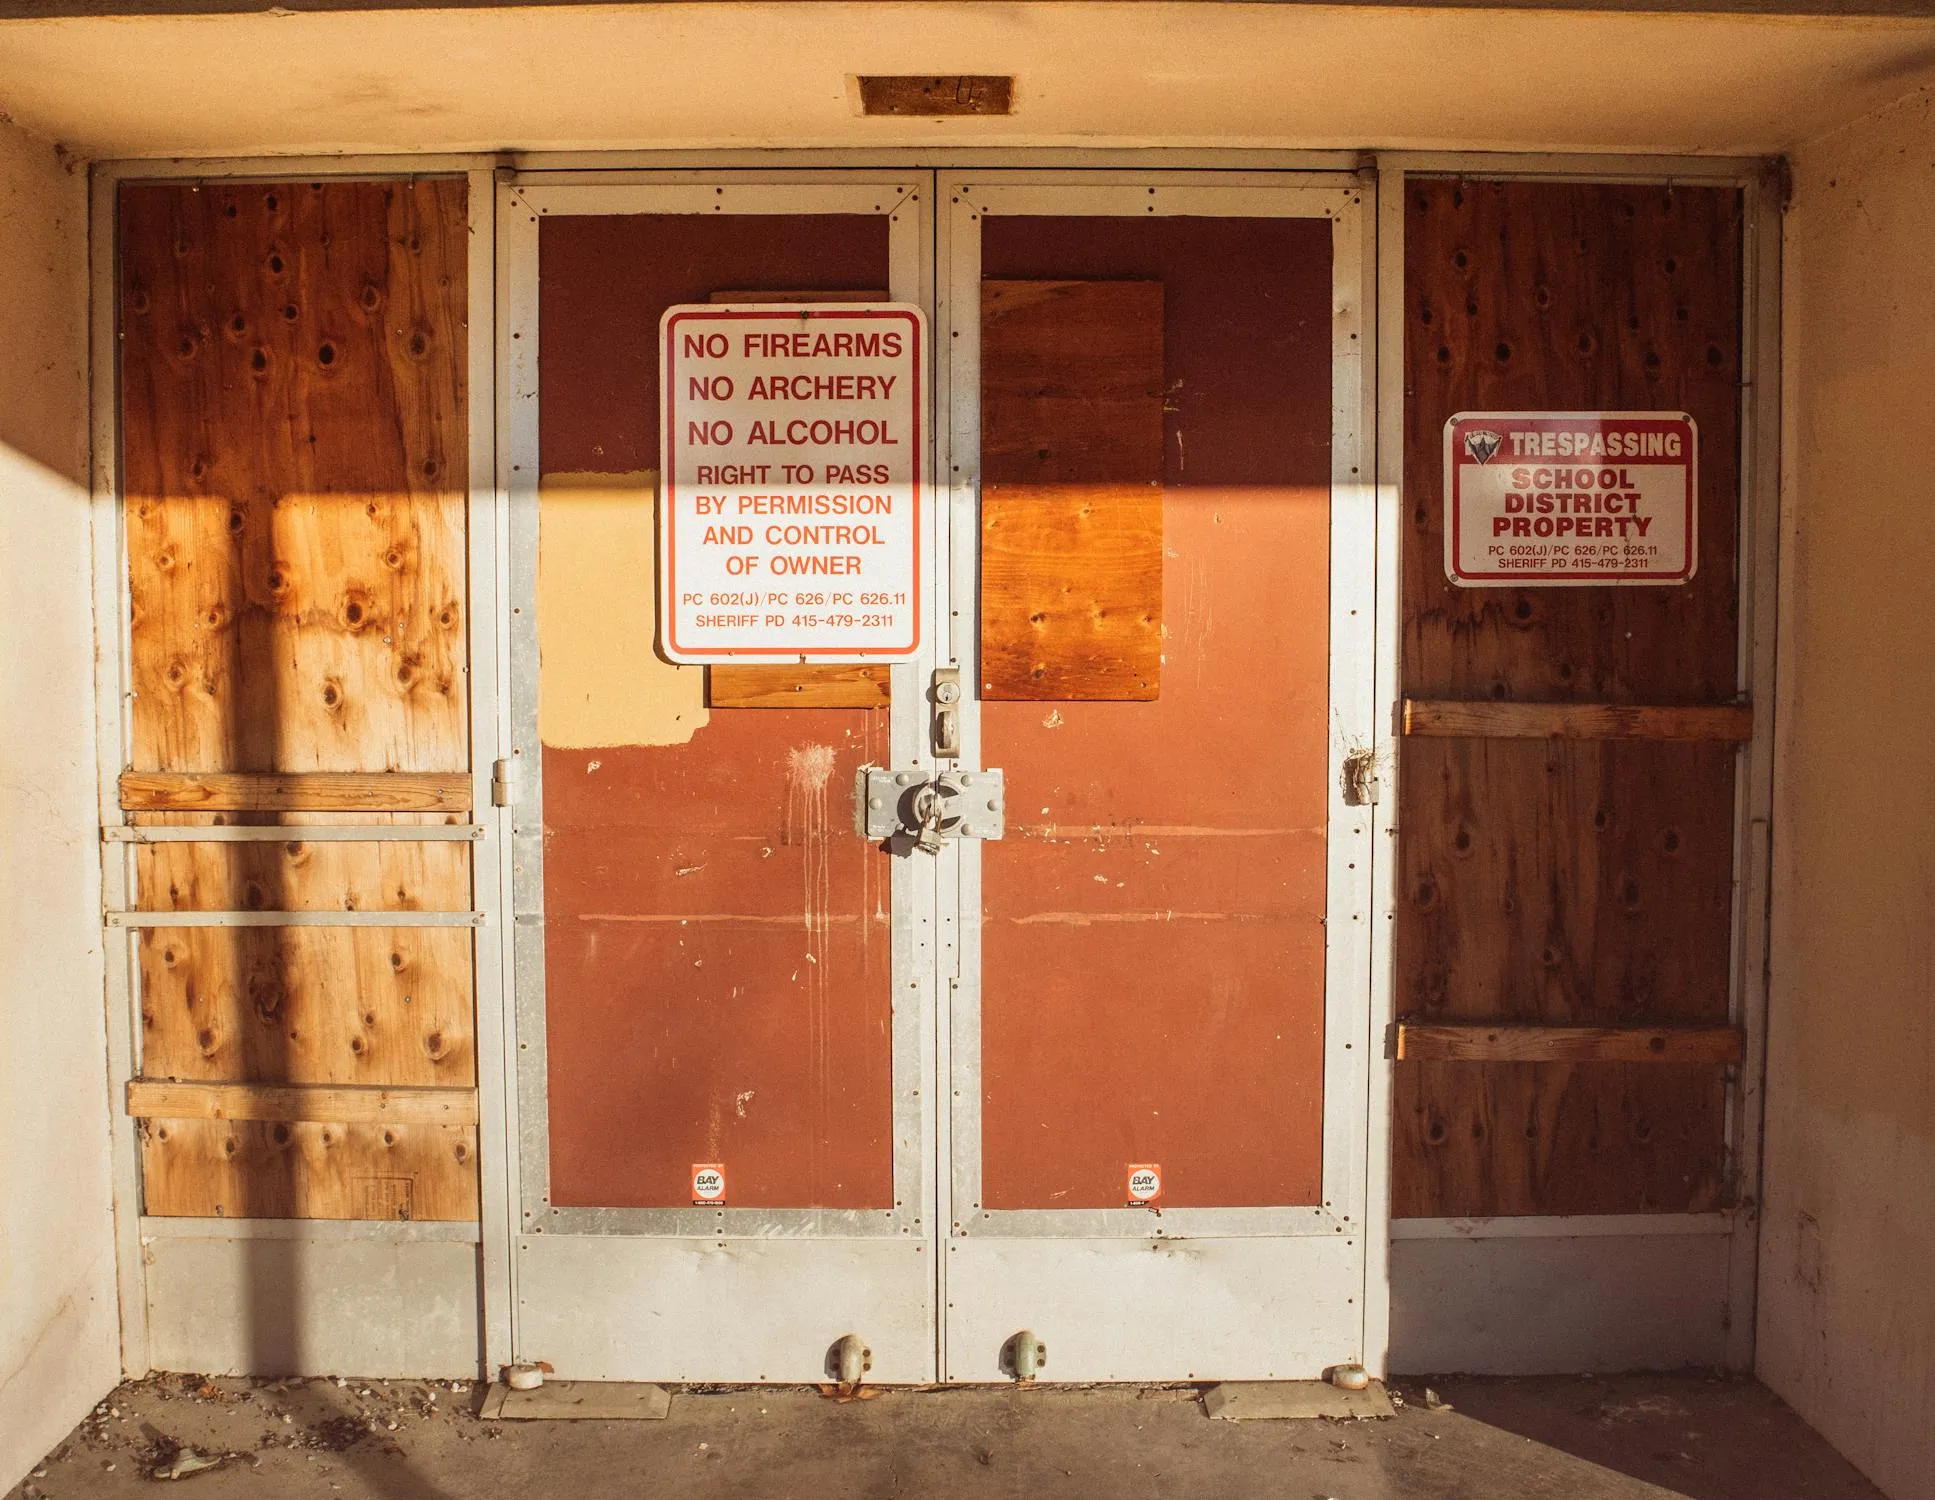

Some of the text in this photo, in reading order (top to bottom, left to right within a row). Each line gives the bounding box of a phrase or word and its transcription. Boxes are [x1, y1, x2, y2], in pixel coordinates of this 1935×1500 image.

[684, 333, 902, 358] NO FIREARMS
[689, 375, 896, 401] NO ARCHERY
[688, 420, 898, 445] NO ALCOHOL
[1510, 432, 1681, 456] TRESPASSING
[697, 465, 889, 485] RIGHT TO PASS
[1512, 468, 1635, 490] SCHOOL
[696, 495, 892, 515] BY PERMISSION
[1505, 493, 1642, 514] DISTRICT
[703, 525, 885, 545] AND CONTROL
[1493, 516, 1653, 538] PROPERTY
[1489, 546, 1504, 556] PC
[1624, 545, 1658, 556] 626.11
[726, 556, 861, 576] OF OWNER
[1498, 558, 1649, 569] SHERIFF PD 415-479-2311
[683, 593, 703, 606] PC
[860, 593, 906, 606] 626.11
[696, 614, 893, 628] SHERIFF PD 415-479-2311
[697, 1176, 718, 1184] BAY
[1132, 1176, 1155, 1184] BAY
